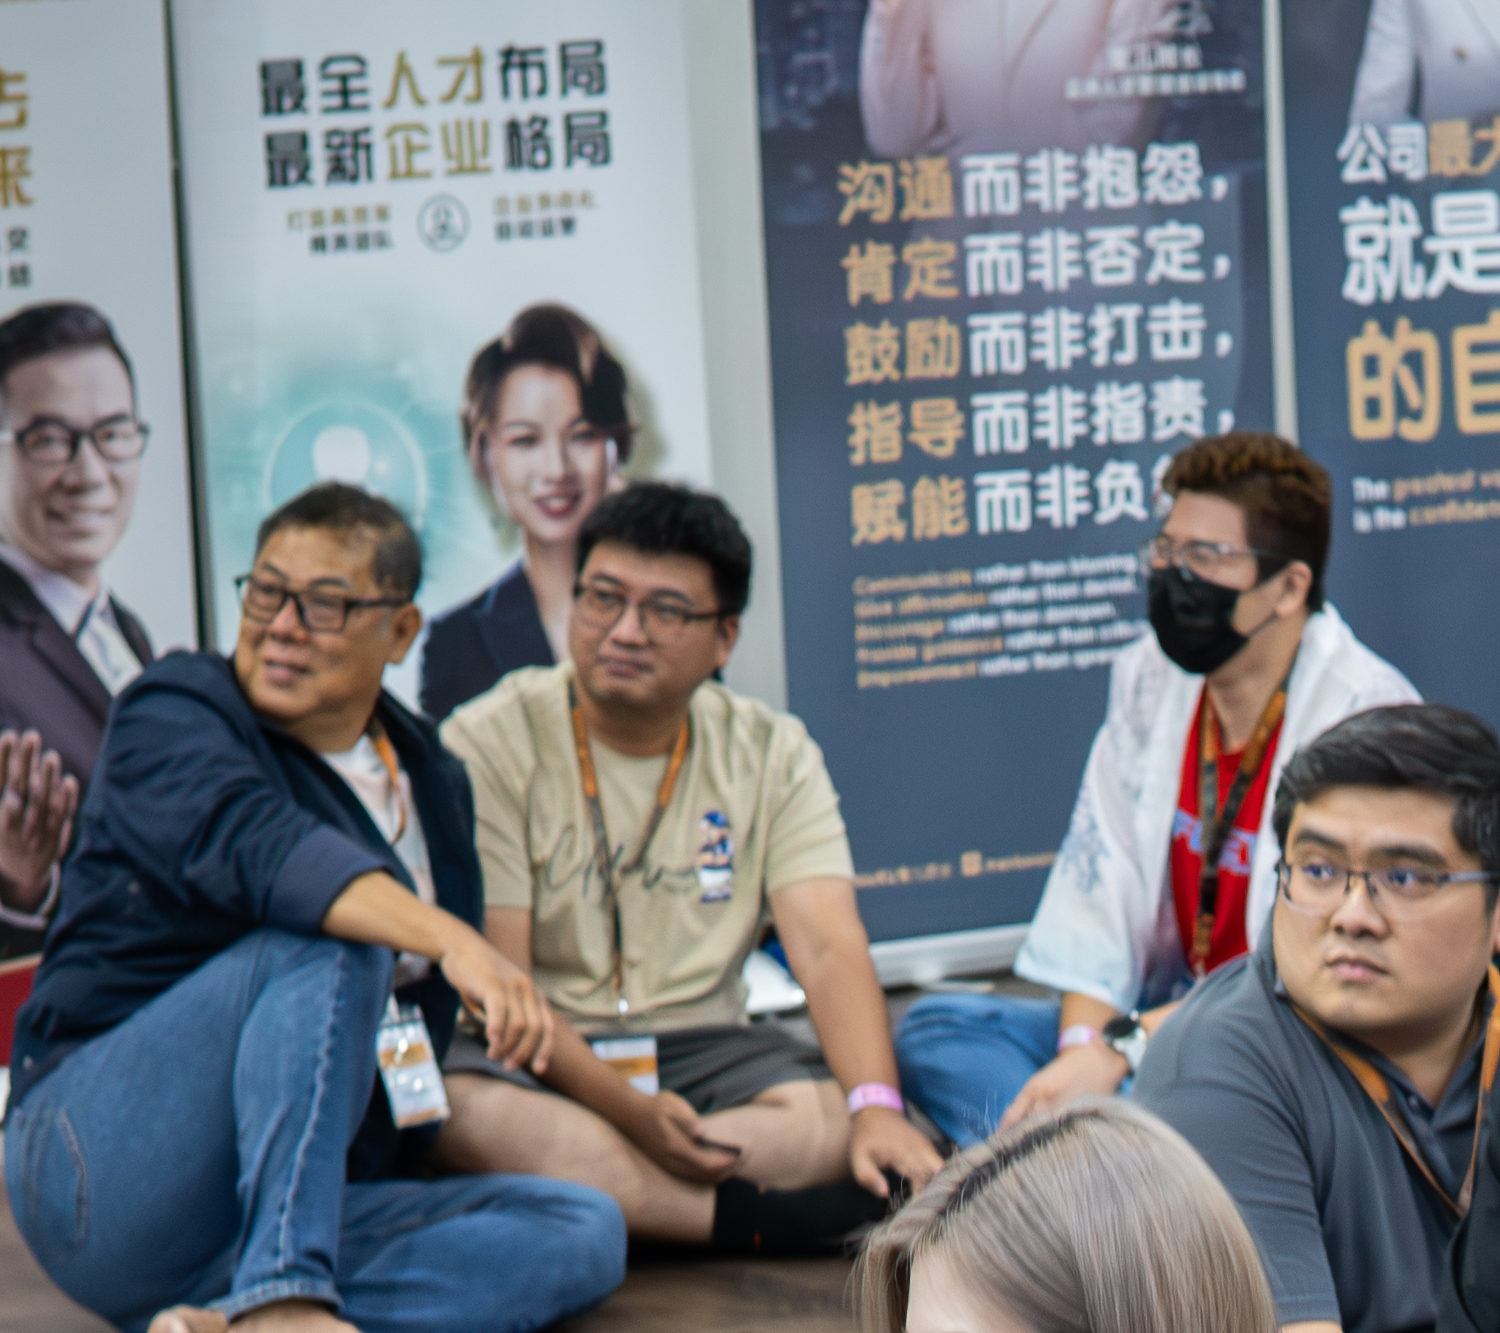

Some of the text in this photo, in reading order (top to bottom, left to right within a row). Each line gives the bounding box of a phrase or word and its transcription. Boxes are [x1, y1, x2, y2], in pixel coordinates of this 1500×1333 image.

[259, 38, 607, 118] 最全人才布局
[264, 110, 613, 190] 最新企业格局
[851, 454, 1175, 548] 赋能而非负
[1351, 475, 1390, 502] The
[1351, 506, 1373, 534] is
[1373, 504, 1406, 531] the
[974, 562, 1027, 586] rather
[1028, 559, 1067, 580] than
[988, 585, 1040, 607] rather
[1042, 582, 1080, 600] than
[947, 612, 1000, 634] rather
[1002, 609, 1040, 628] than
[1004, 630, 1056, 650] rather
[1058, 626, 1097, 645] than
[979, 655, 1031, 677] rather
[1033, 650, 1071, 672] than
